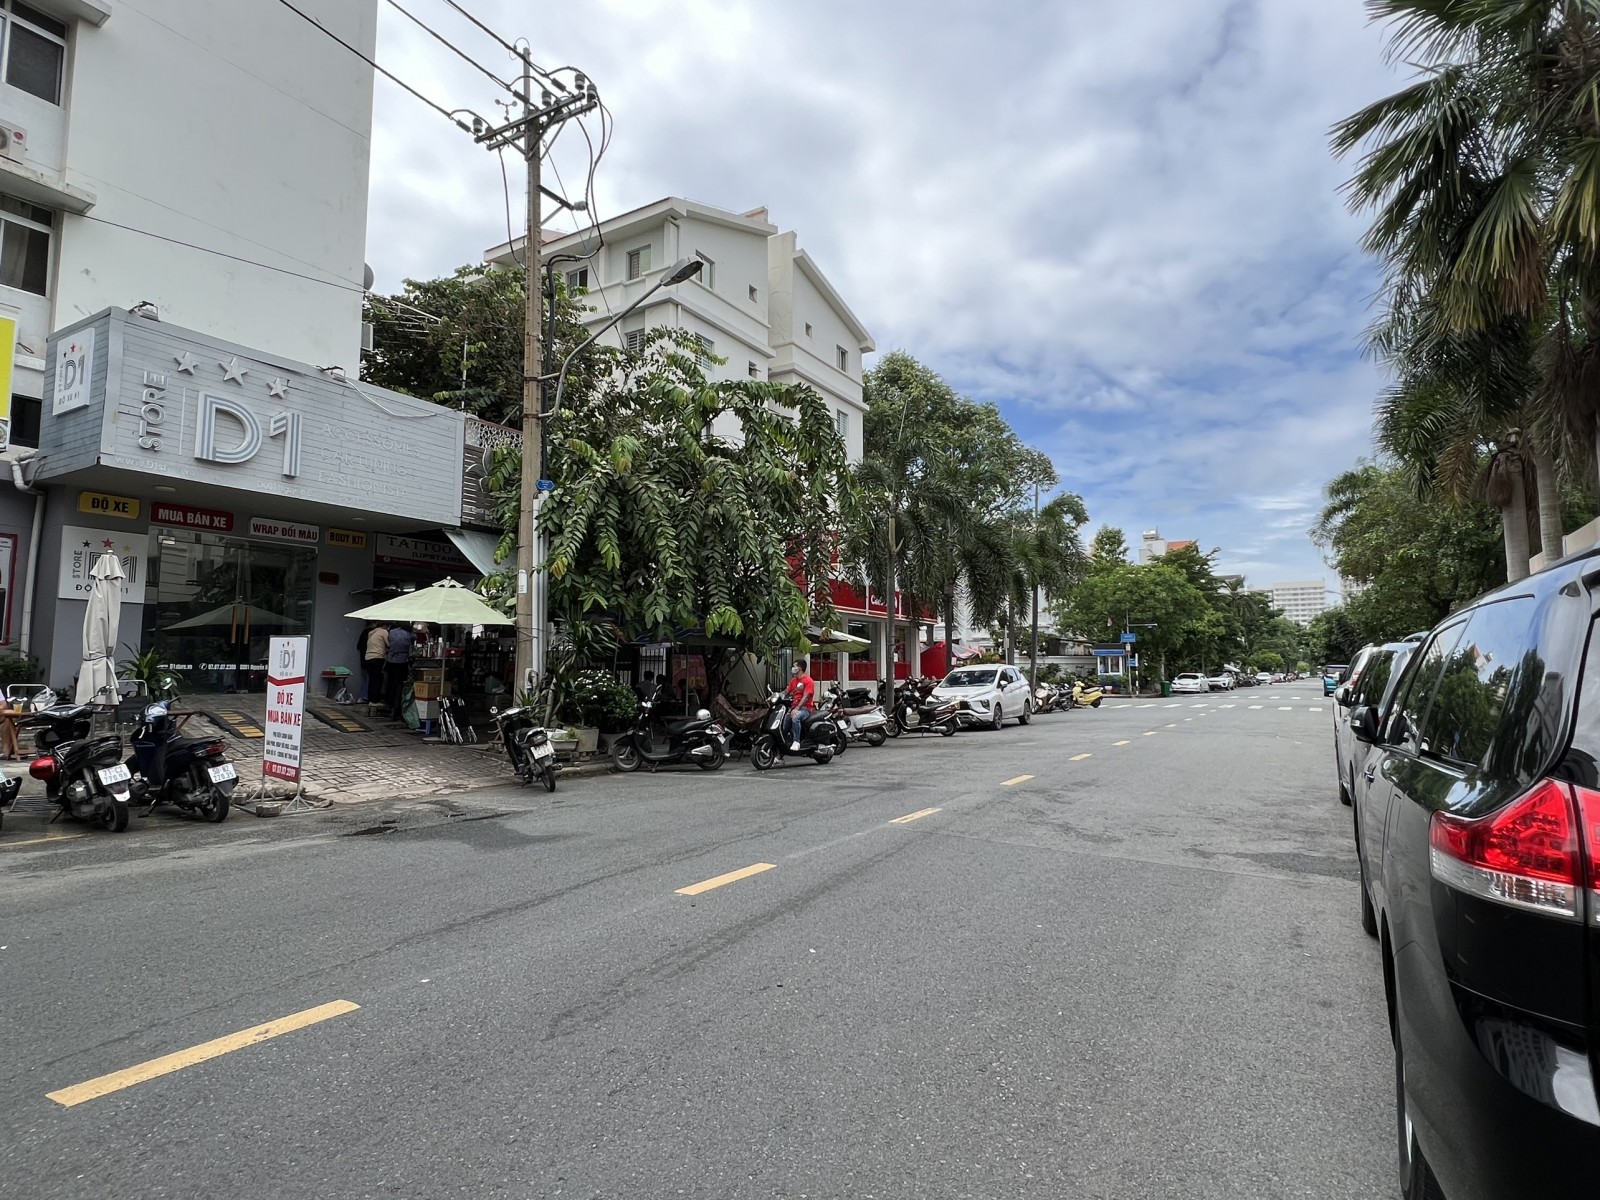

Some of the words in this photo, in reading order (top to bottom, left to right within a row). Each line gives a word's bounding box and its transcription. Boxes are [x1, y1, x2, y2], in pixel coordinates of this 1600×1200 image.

[64, 354, 86, 390] D1
[138, 370, 168, 451] STORE
[194, 391, 302, 477] D1
[321, 423, 421, 457] ACCESSORIES
[320, 447, 354, 466] CAR
[91, 497, 109, 513] ĐỘ
[112, 500, 129, 513] XE
[158, 508, 184, 522] MUA
[187, 511, 210, 526] BÁN
[213, 517, 227, 528] XE
[252, 523, 279, 535] WRAP
[329, 531, 350, 544] BODY
[352, 534, 365, 546] KIT
[386, 536, 452, 554] TATTOO
[72, 550, 83, 579] STORE
[286, 692, 294, 705] XE
[267, 709, 279, 723] MUA
[280, 709, 293, 726] BÁN
[293, 713, 301, 727] XE
